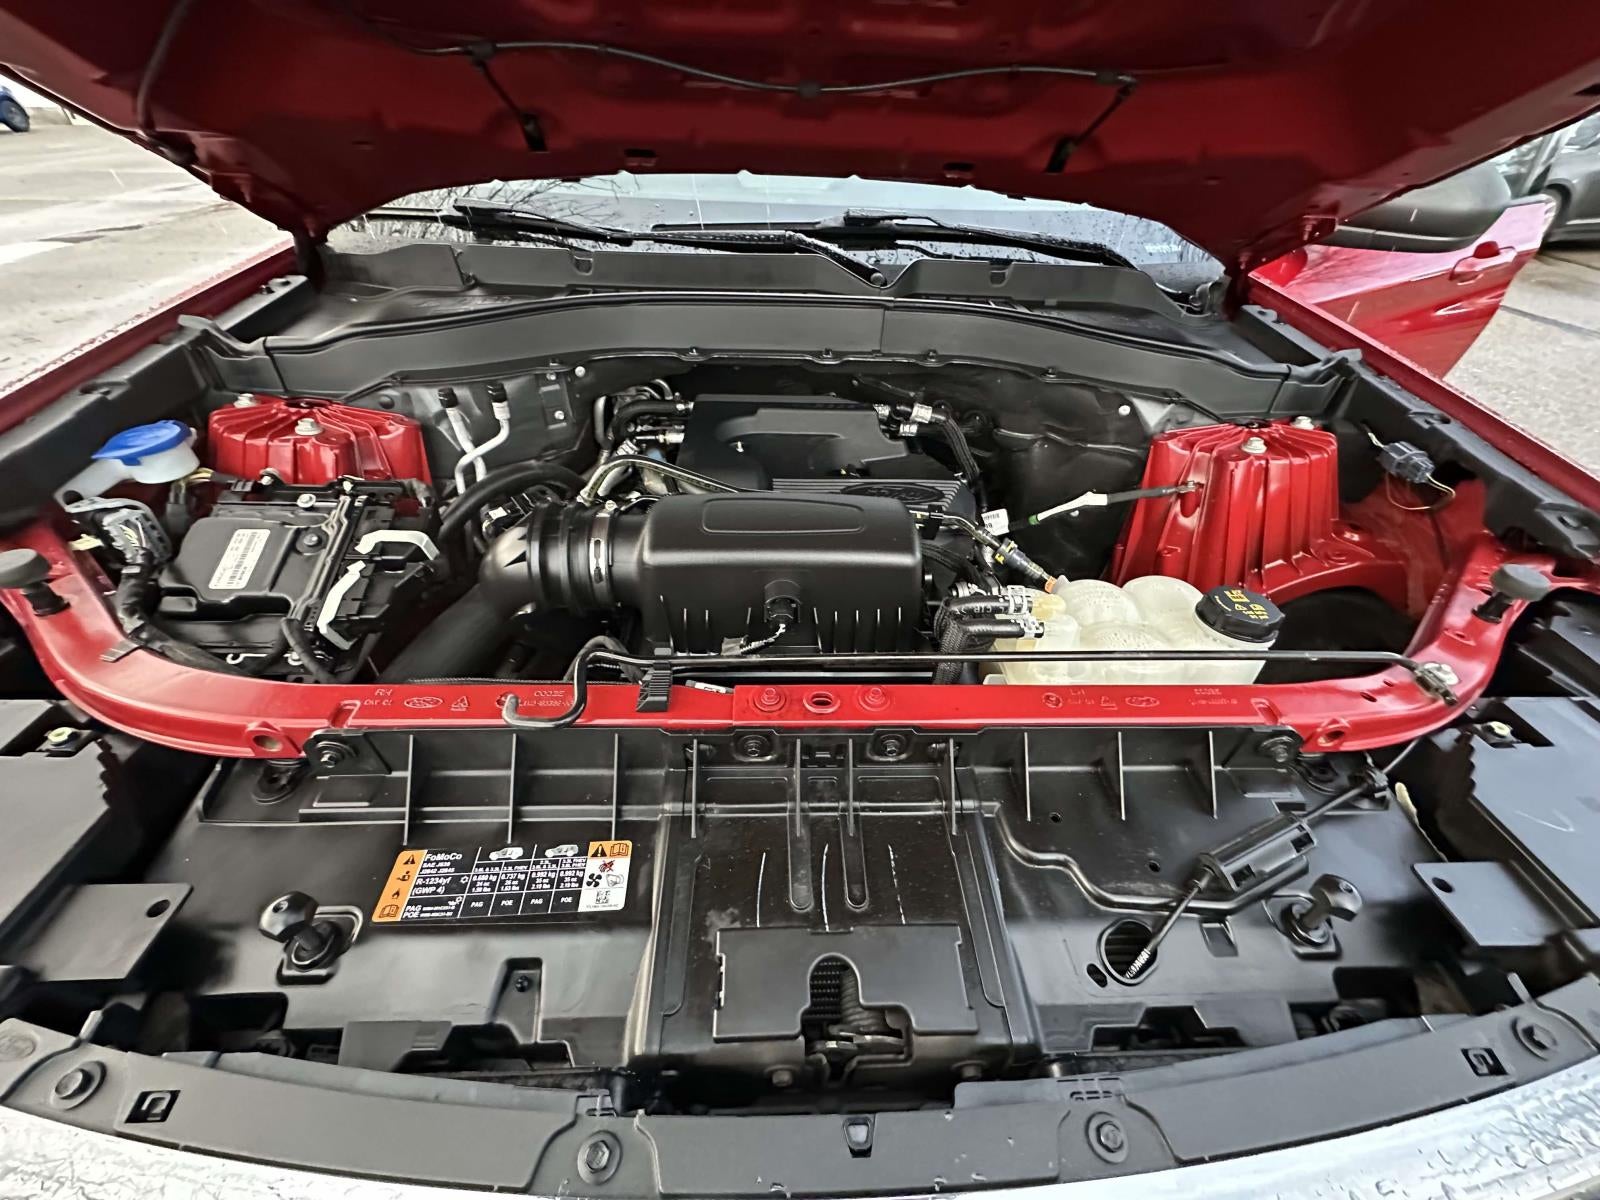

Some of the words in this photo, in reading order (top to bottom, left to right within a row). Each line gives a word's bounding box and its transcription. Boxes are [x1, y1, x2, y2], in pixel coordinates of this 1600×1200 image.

[424, 853, 463, 861] FoMoCo
[416, 876, 452, 885] R-1234yf
[411, 887, 436, 896] (GWP
[436, 886, 446, 894] 4)
[405, 904, 422, 912] PAG
